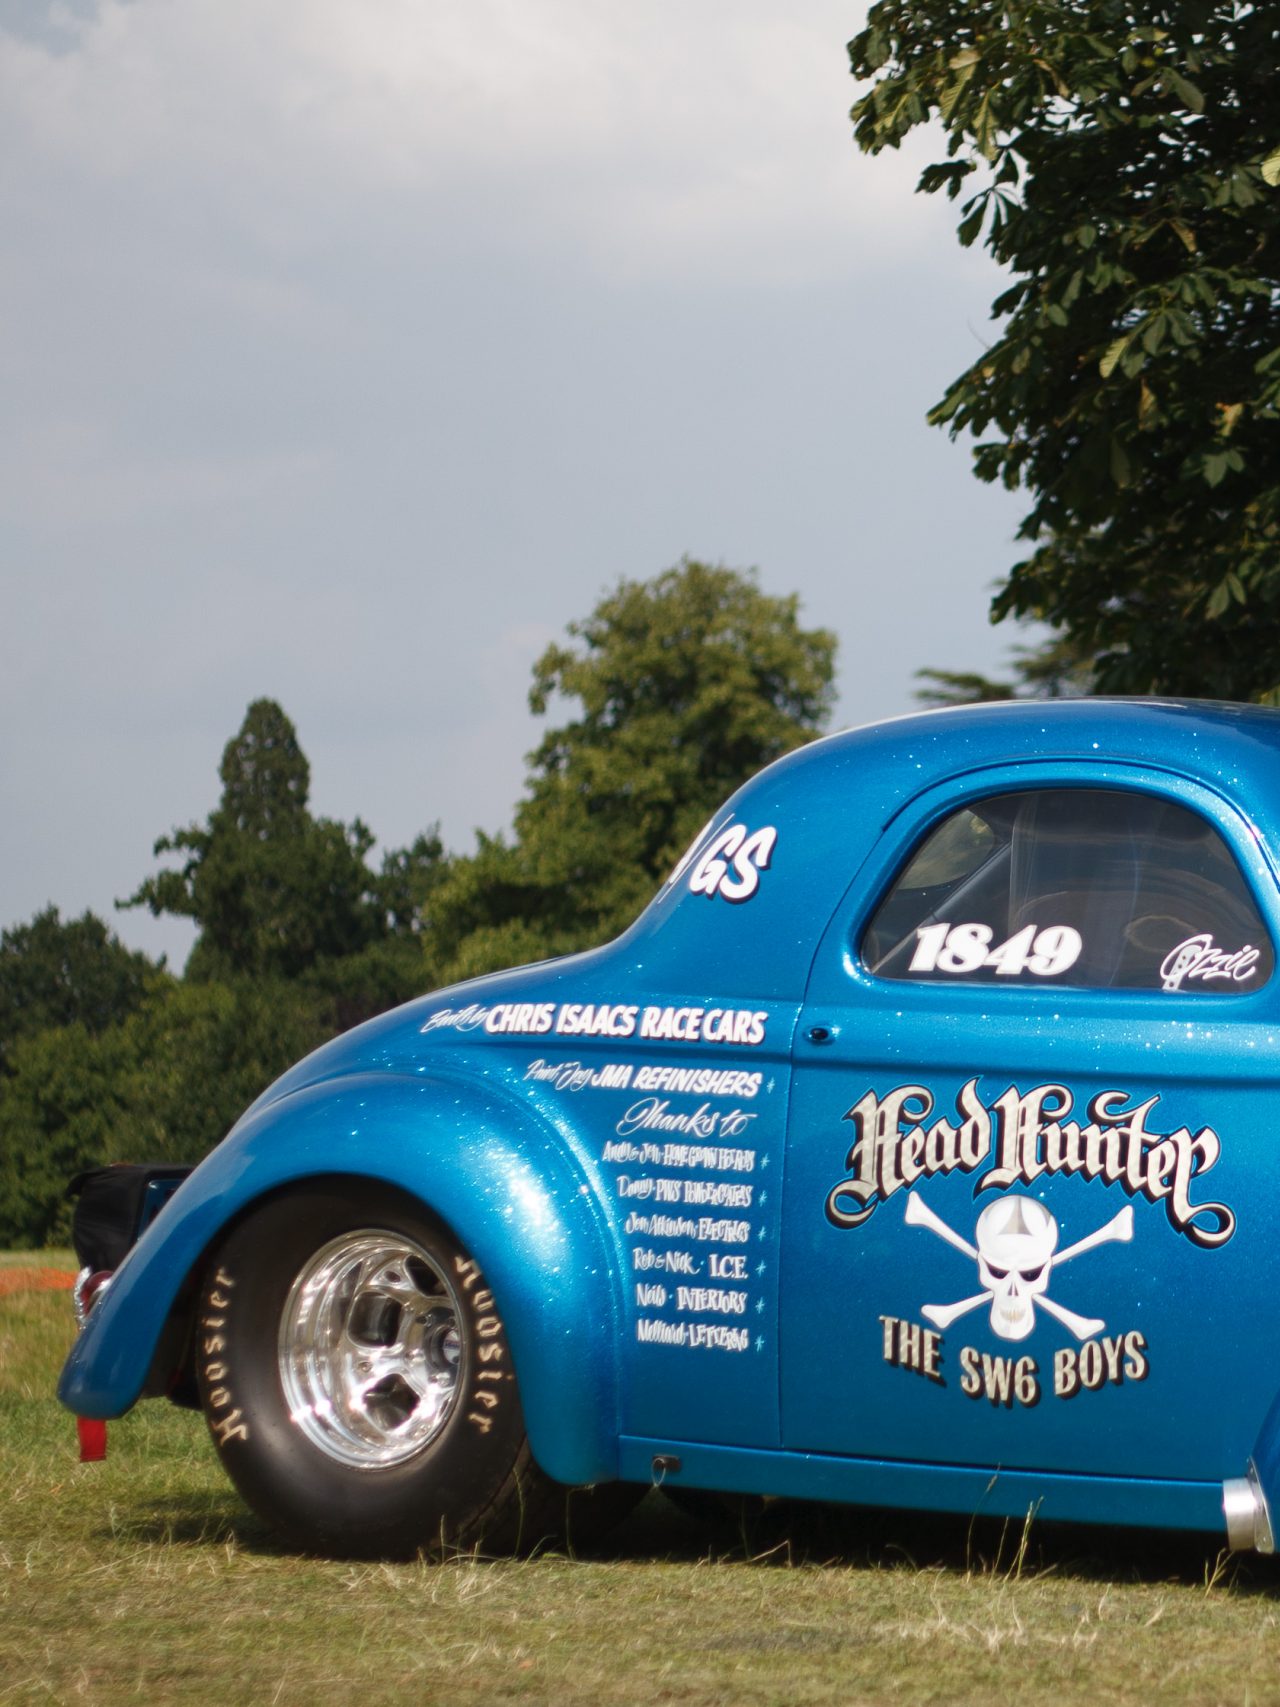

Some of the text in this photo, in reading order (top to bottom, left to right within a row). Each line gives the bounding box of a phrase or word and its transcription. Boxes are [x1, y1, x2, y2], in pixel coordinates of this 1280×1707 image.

[670, 820, 777, 904] GS
[908, 922, 1083, 976] 1849
[1160, 933, 1260, 981] Ozzie
[420, 1004, 480, 1033] Built
[485, 1003, 556, 1036] CHRIS
[556, 1005, 641, 1039] ISAACS
[641, 1007, 703, 1042] RACE
[702, 1010, 769, 1045] CARS
[591, 1064, 631, 1088] JMA
[632, 1066, 764, 1098] REFINISHERS
[616, 1097, 758, 1137] Thanks to
[825, 1075, 1238, 1250] Head Hunter
[655, 1178, 682, 1202] PWS
[633, 1246, 655, 1271] Rob
[665, 1249, 701, 1275] Nick
[708, 1253, 749, 1280] I.C.E.
[676, 1286, 748, 1315] INTERIORS
[201, 1266, 249, 1448] Hoosier
[453, 1255, 515, 1434] Hoosier
[687, 1322, 749, 1352] LETTERING
[879, 1315, 1150, 1410] THE SW6 BOYS
